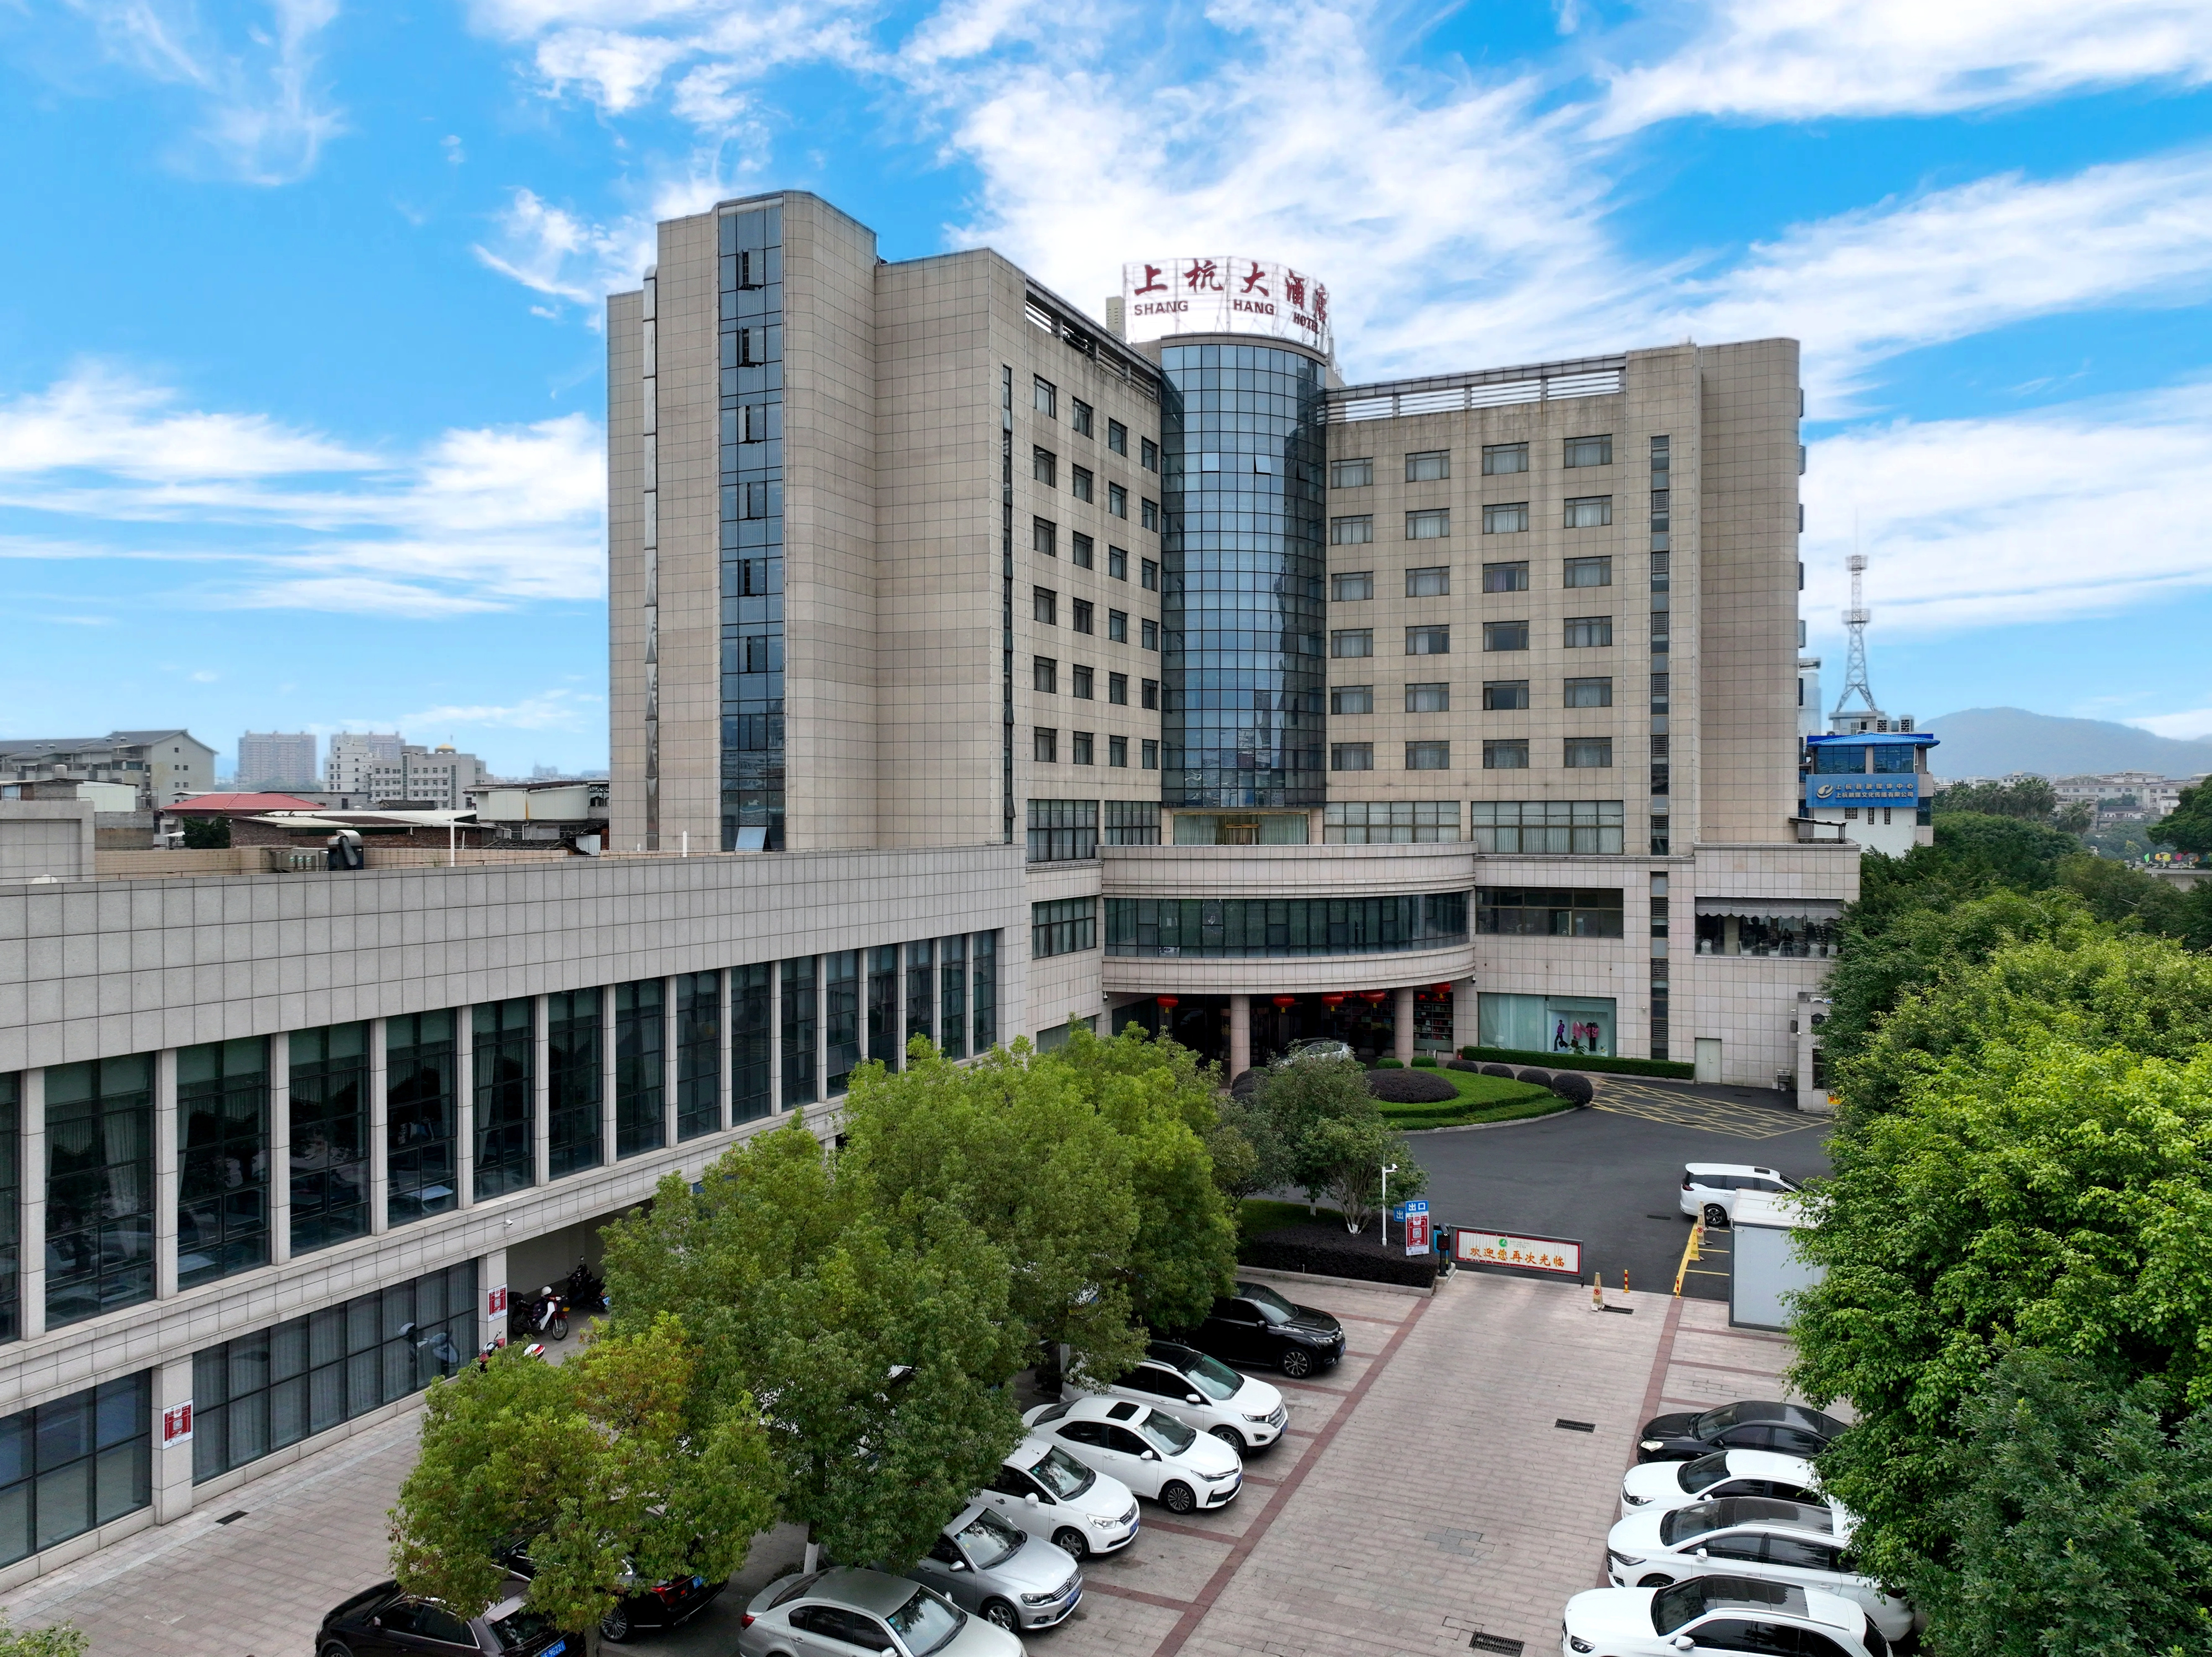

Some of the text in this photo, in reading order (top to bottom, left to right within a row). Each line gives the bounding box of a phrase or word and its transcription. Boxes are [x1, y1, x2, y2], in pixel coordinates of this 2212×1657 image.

[1134, 258, 1327, 321] 上杭大酒店
[1134, 299, 1320, 334] SHANG HANG HOTEL
[1408, 1203, 1426, 1211] 出口
[1470, 1245, 1565, 1267] 欢迎您再次光临
